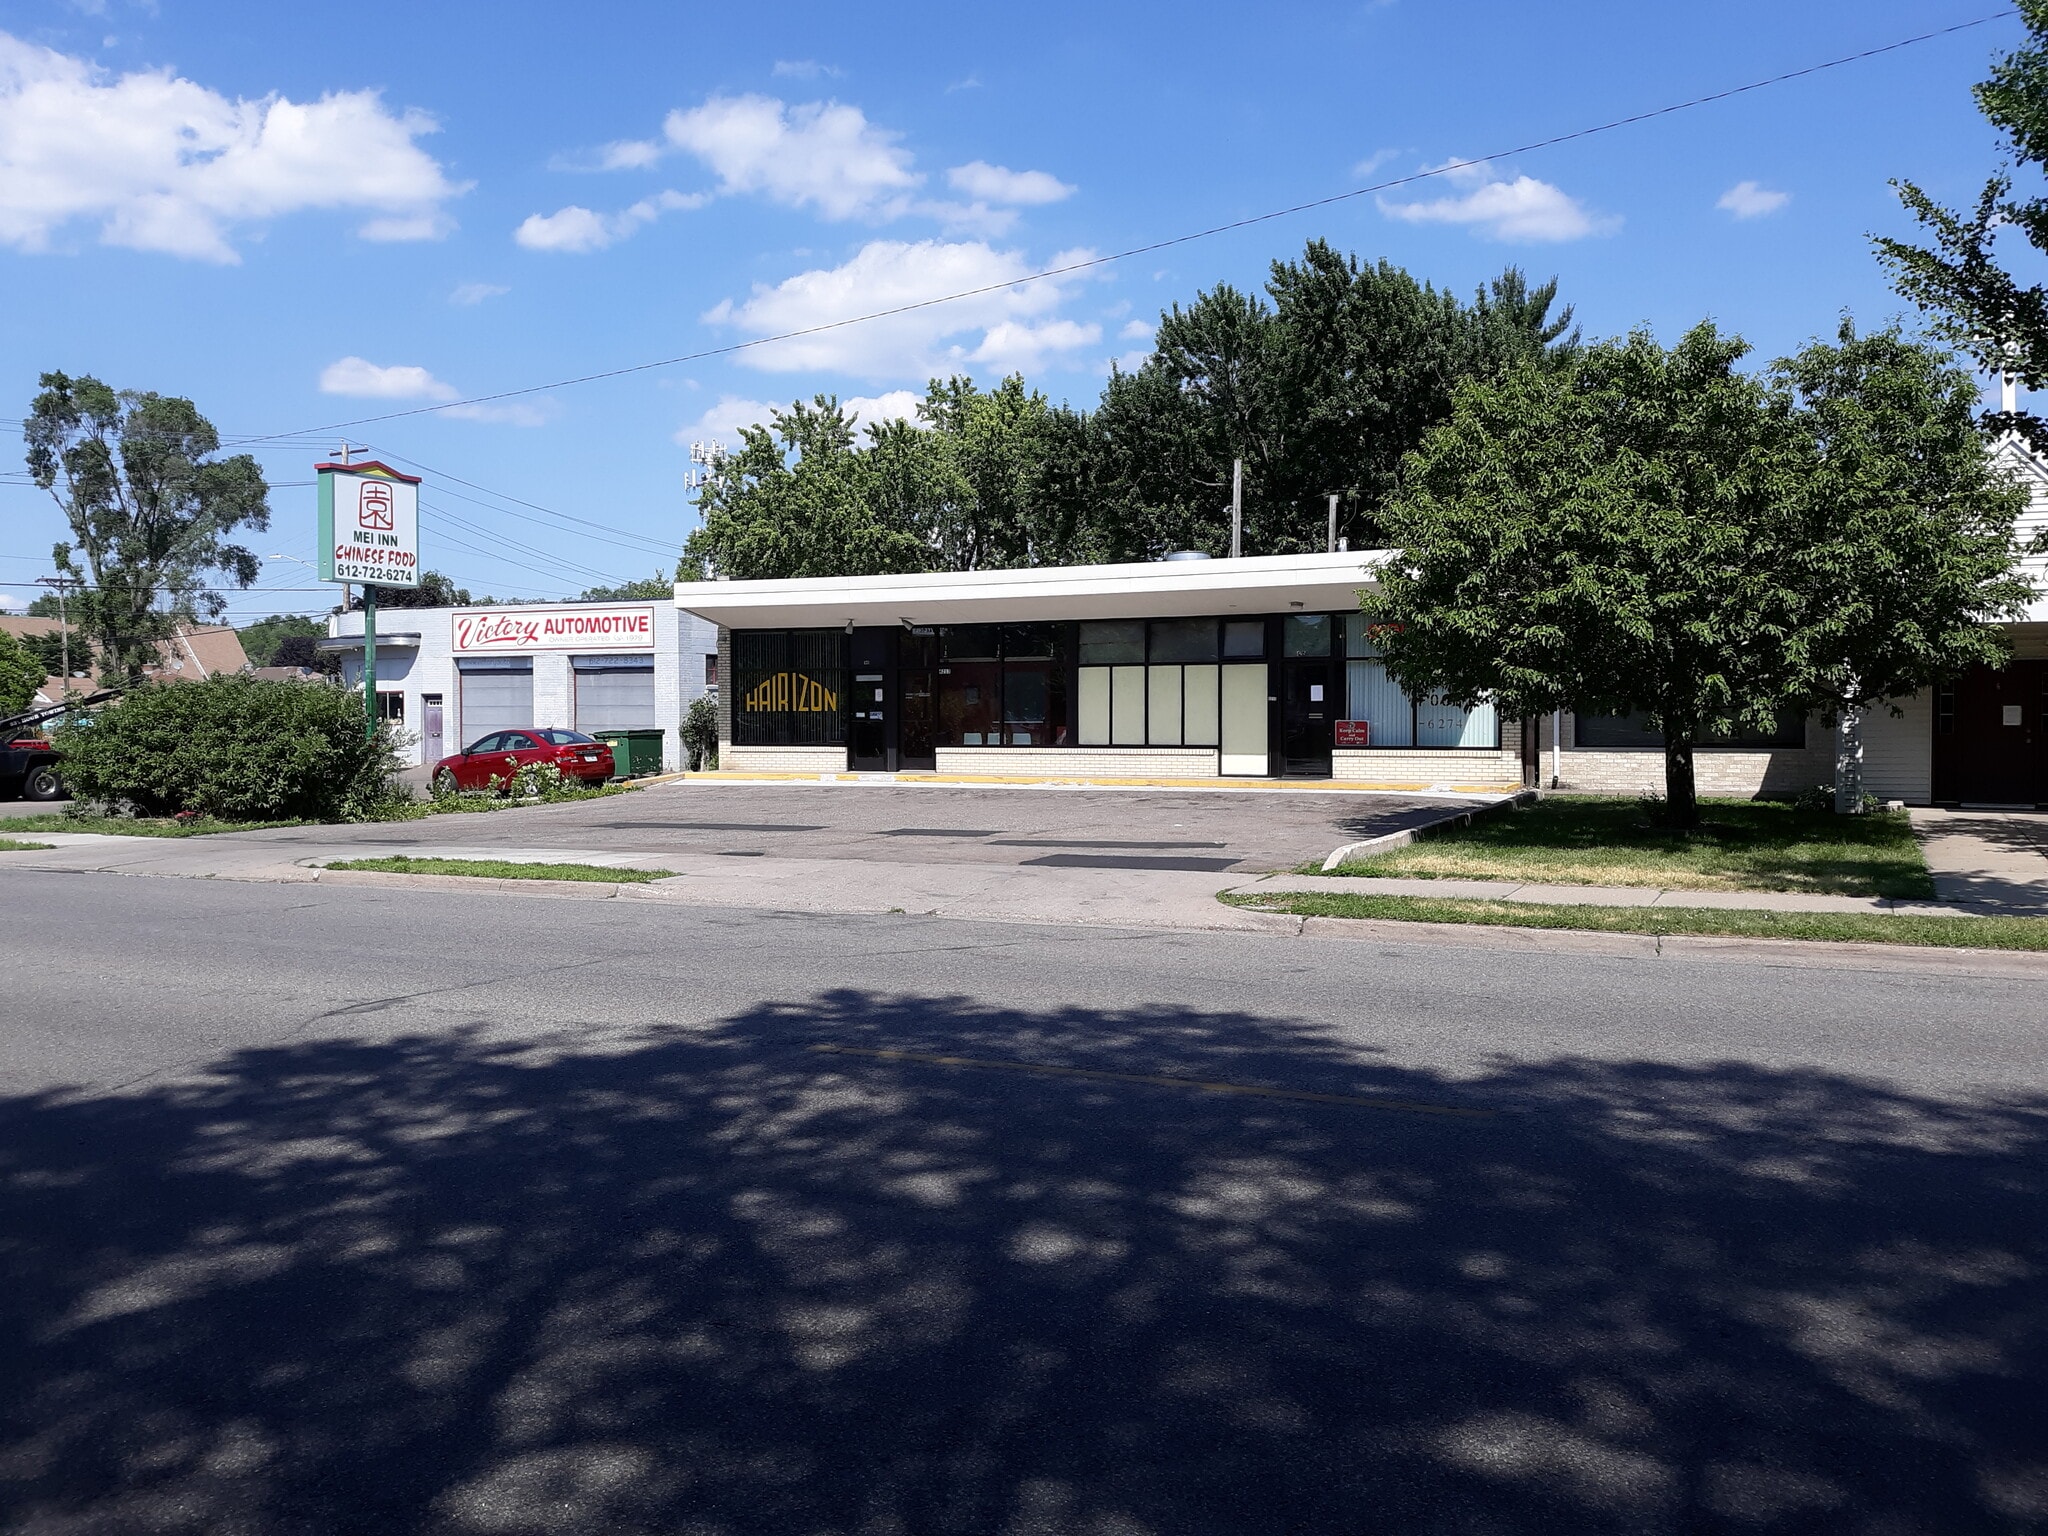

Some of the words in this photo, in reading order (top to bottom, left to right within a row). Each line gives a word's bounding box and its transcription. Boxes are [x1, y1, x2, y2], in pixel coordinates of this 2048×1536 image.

[353, 530, 374, 544] MEI
[378, 533, 398, 547] INN
[335, 545, 384, 565] CHINESE
[388, 550, 416, 567] FOOD
[337, 564, 412, 582] 612-722-6274
[458, 616, 540, 648] Victory
[544, 616, 649, 634] AUTOMOTIVE
[746, 672, 837, 712] HAIRIZON
